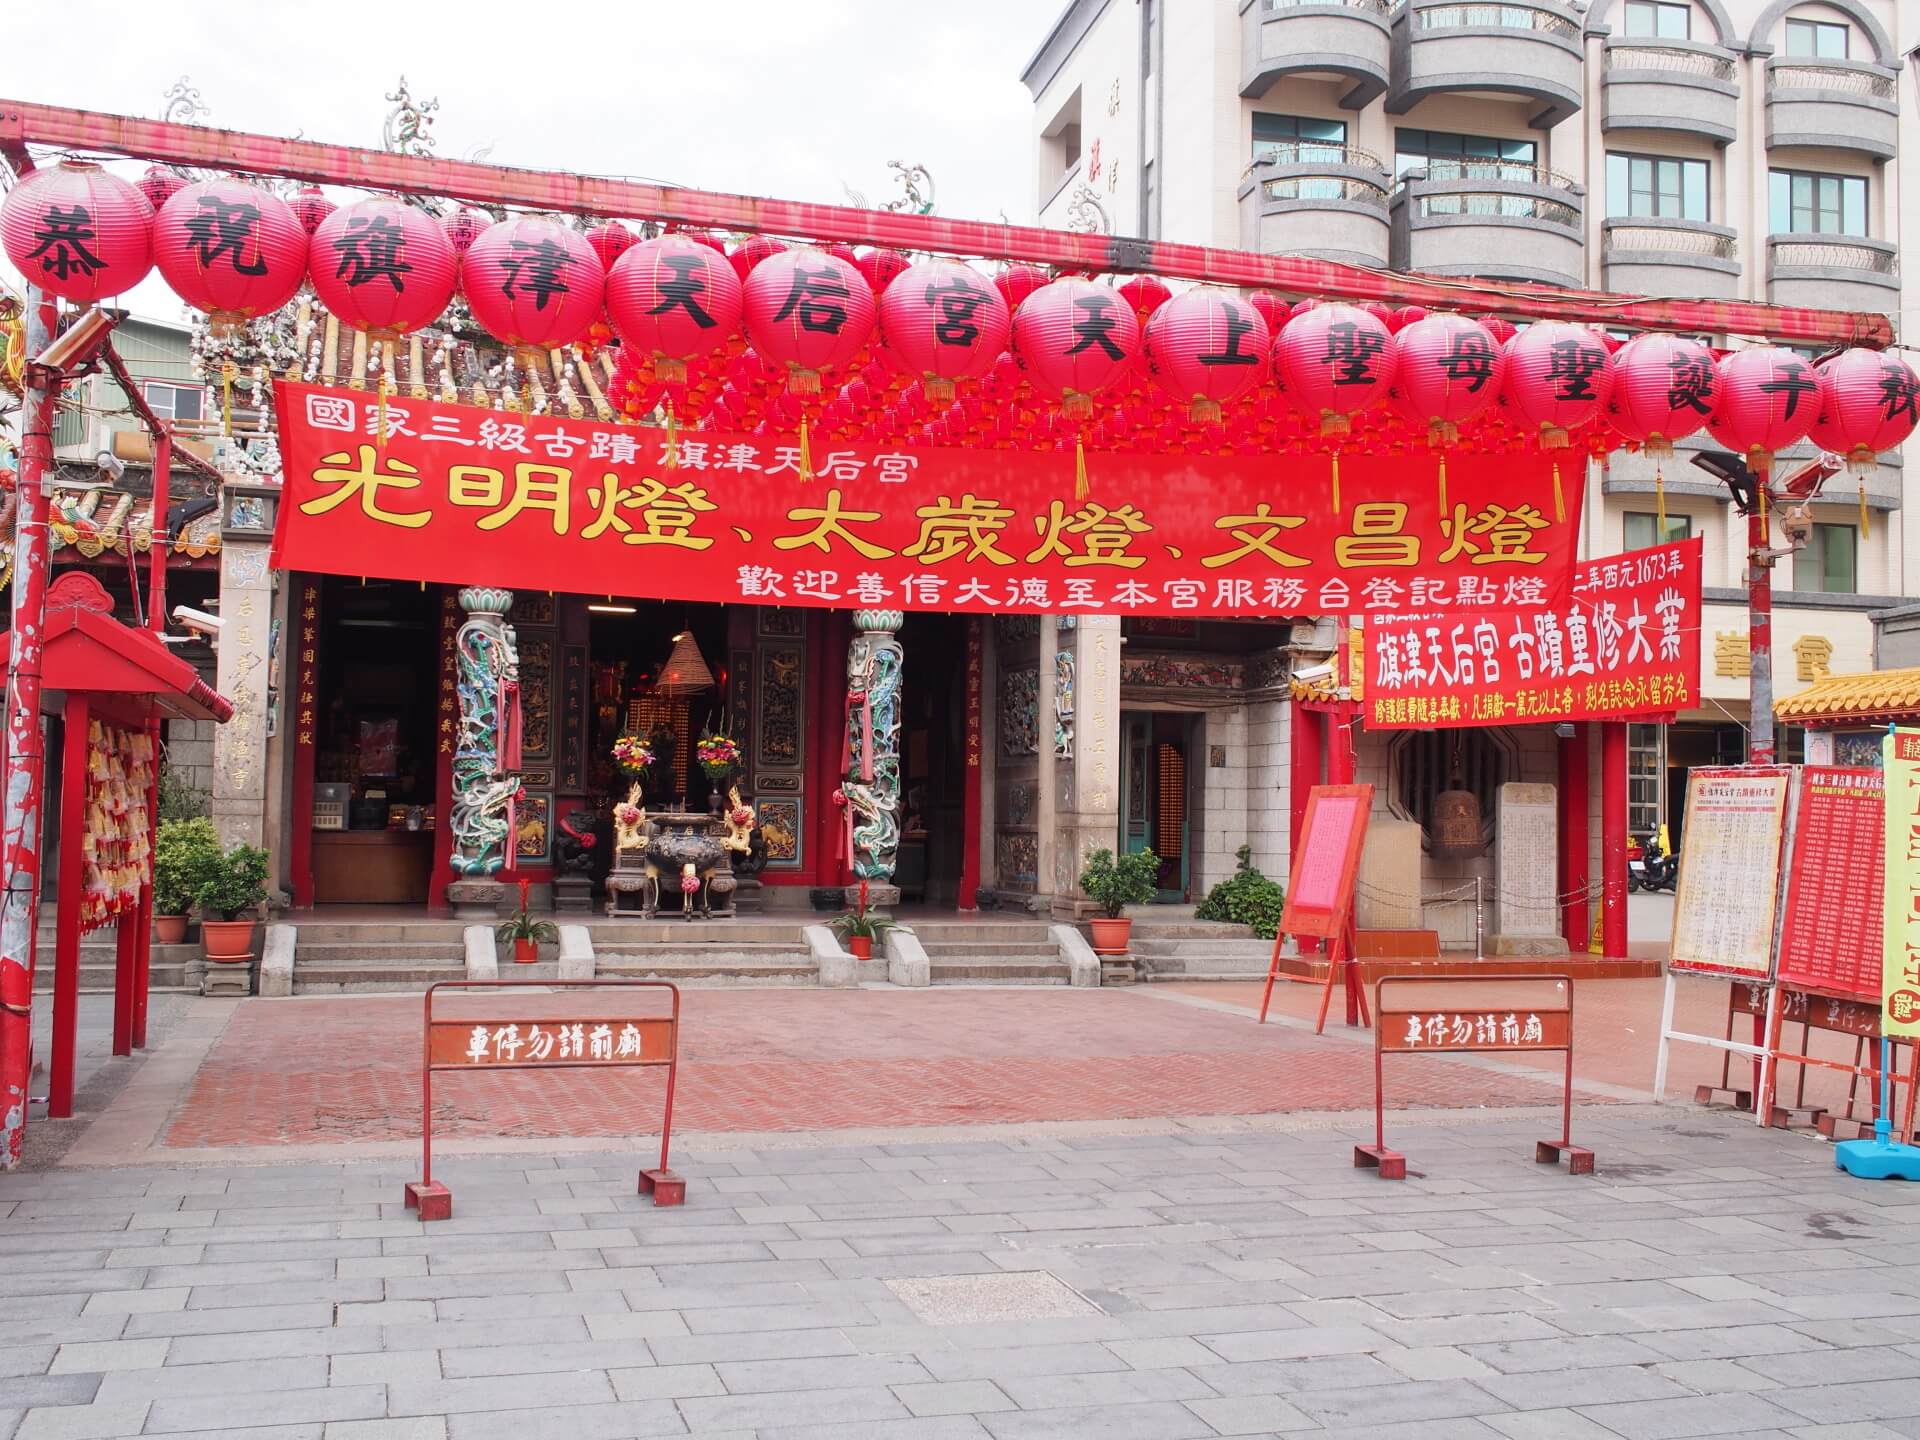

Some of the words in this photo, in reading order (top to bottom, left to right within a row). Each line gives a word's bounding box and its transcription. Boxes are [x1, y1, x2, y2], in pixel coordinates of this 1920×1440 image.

[305, 391, 643, 466] 國家三級古蹟
[657, 439, 919, 484] 旗津天后宮
[735, 564, 1549, 610] 歡迎善信大德至本宮服務台登記點燈
[1376, 616, 1500, 690] 旗津天后宮
[1508, 586, 1686, 680] 古蹟重修大業
